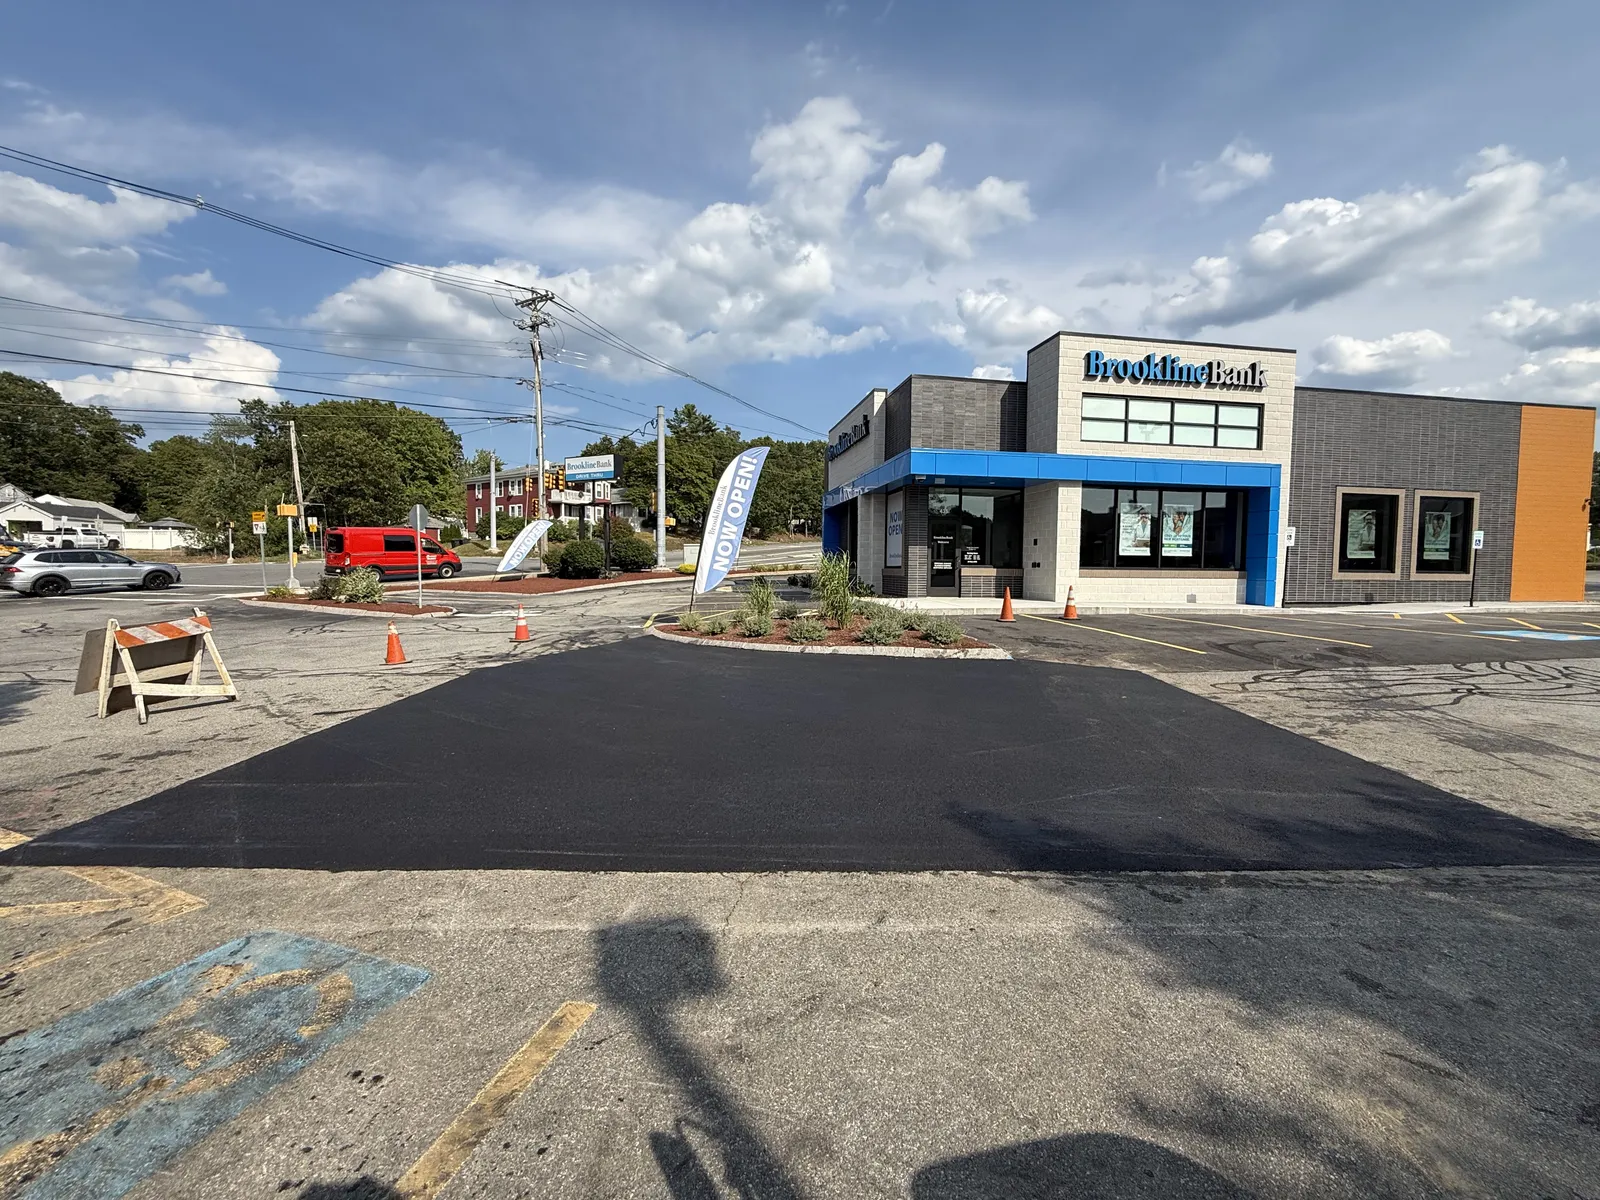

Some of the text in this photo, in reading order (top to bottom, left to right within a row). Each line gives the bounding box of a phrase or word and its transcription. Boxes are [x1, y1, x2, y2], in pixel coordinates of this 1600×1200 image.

[1085, 350, 1269, 388] BrooklineBank
[567, 460, 612, 470] BrooklineBank
[713, 455, 758, 573] NOW OPEN!
[888, 523, 903, 536] OPEN
[509, 543, 528, 566] NOW
